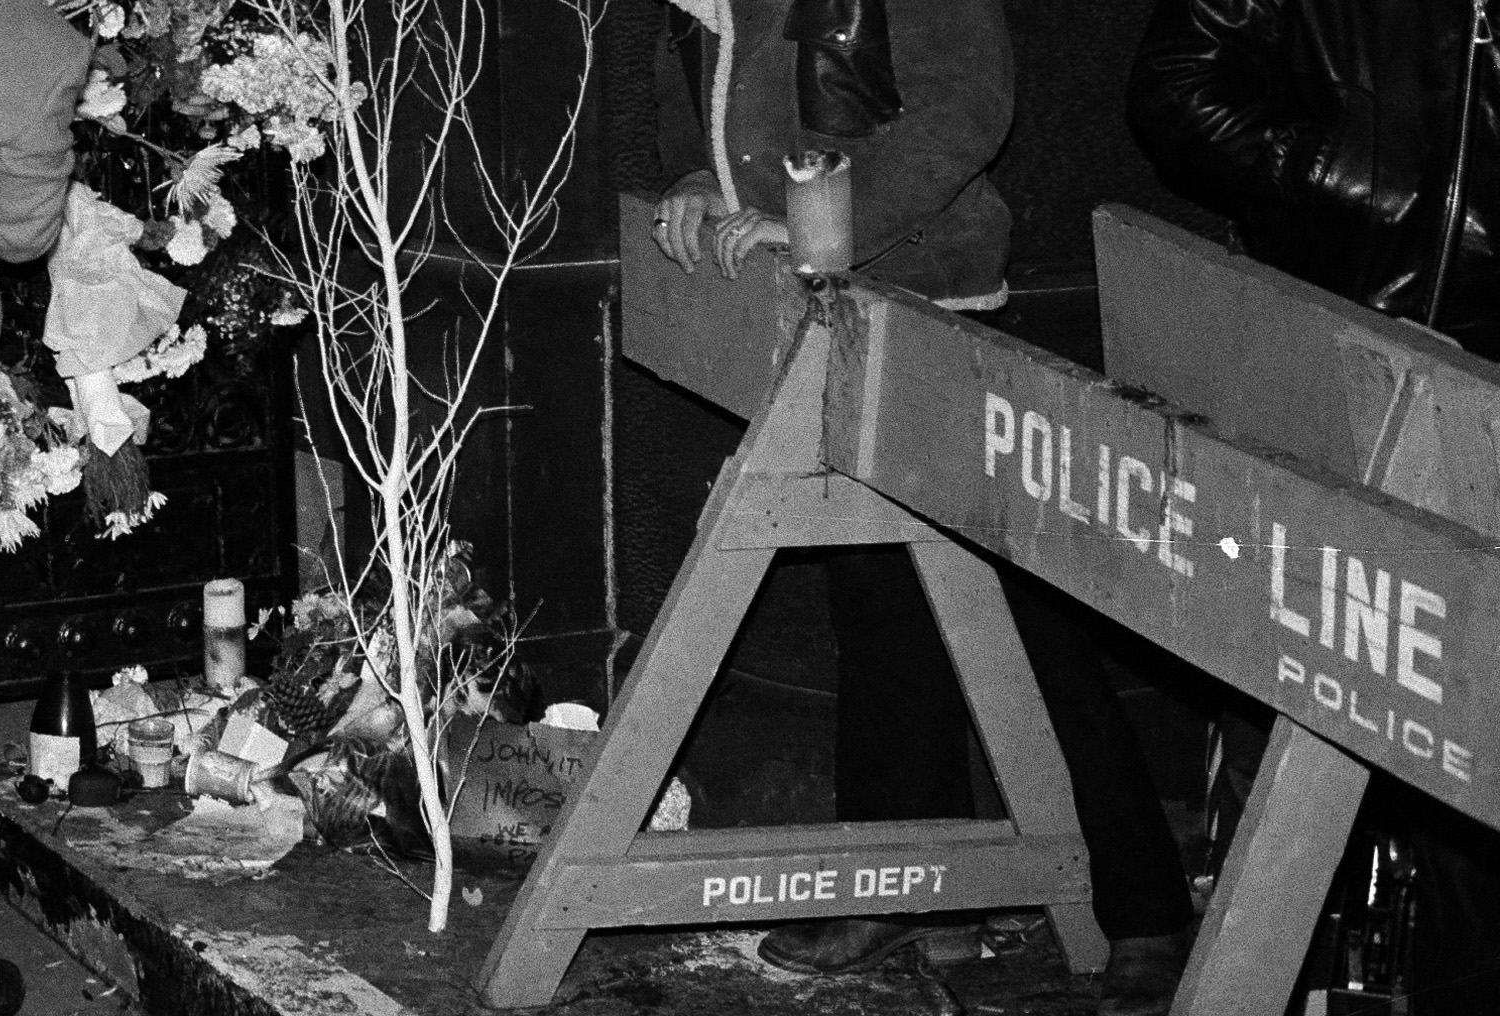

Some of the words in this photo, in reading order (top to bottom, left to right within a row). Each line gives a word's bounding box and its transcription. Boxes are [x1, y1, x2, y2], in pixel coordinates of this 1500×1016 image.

[984, 391, 1197, 579] POLICE
[1270, 521, 1448, 706] LINE
[1277, 654, 1473, 783] POLICE
[703, 870, 838, 906] POLICE
[854, 864, 947, 898] DEPT
